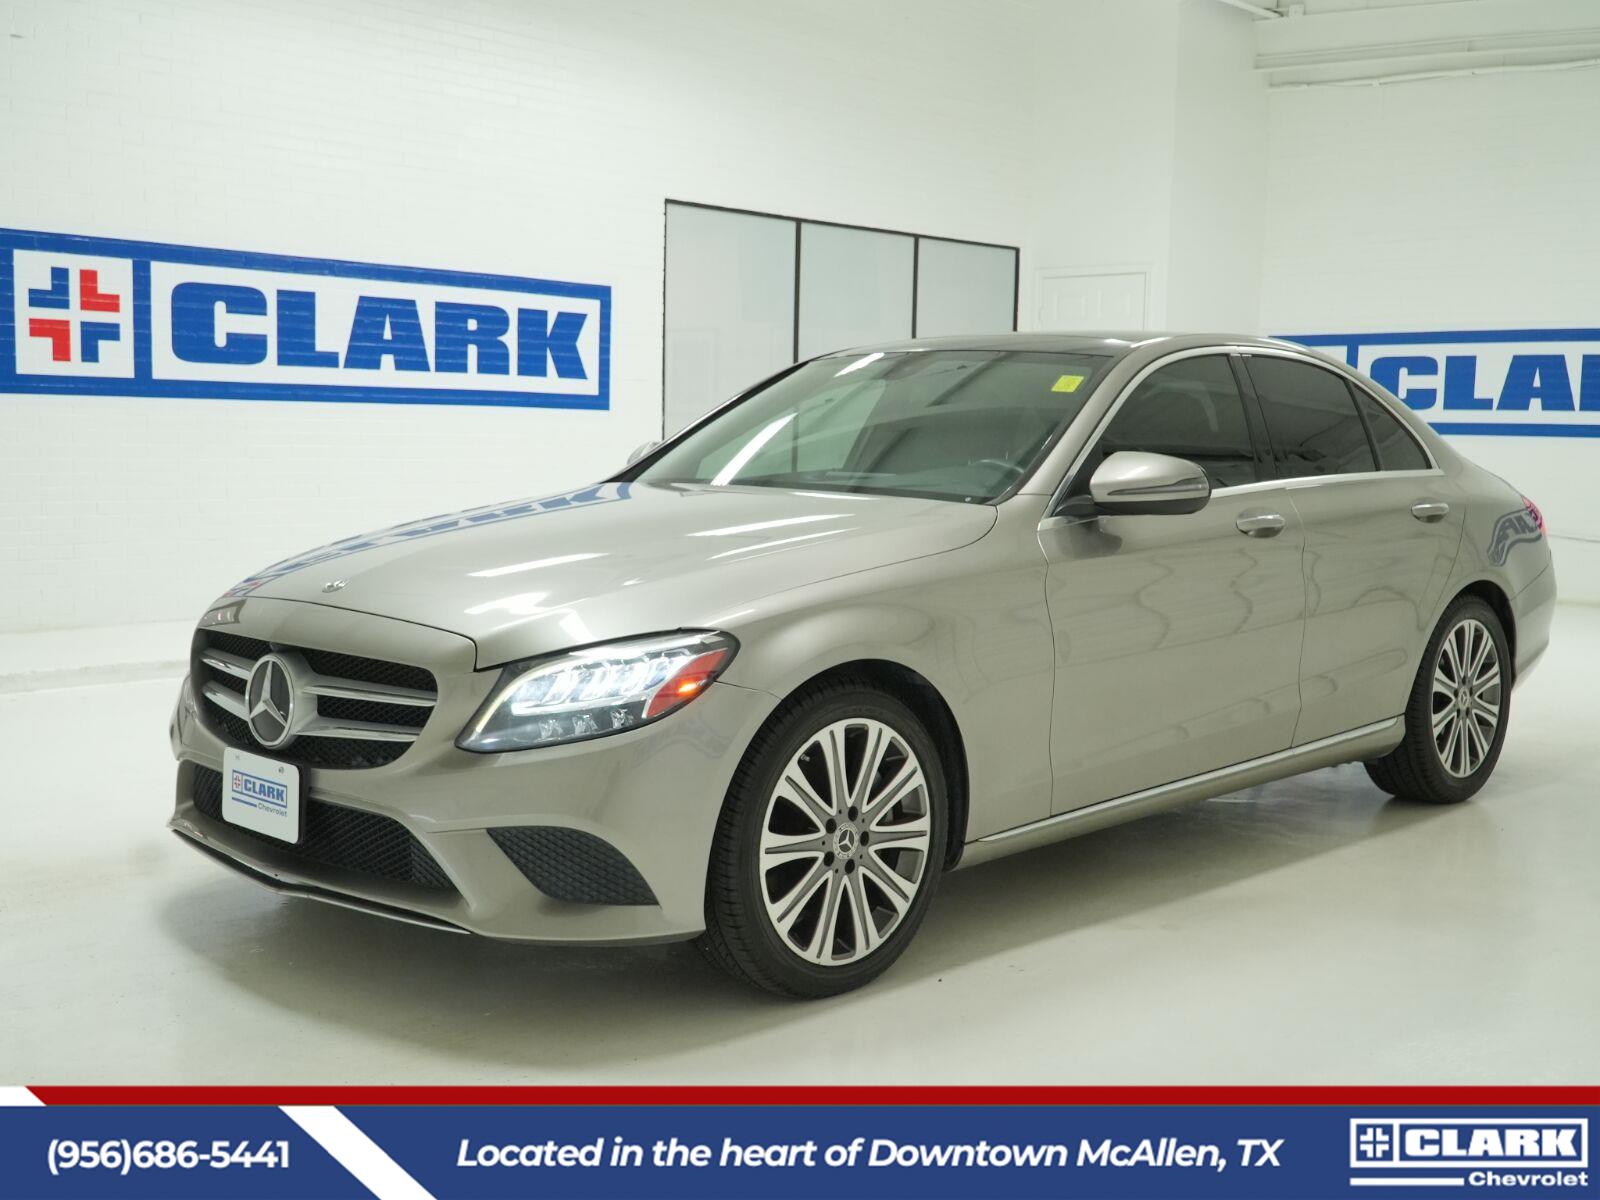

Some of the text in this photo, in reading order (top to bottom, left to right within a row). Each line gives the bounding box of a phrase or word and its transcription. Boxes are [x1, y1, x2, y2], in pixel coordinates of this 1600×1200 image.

[171, 282, 588, 380] CLARK
[1370, 354, 1600, 412] CLA
[244, 779, 284, 802] CLARK
[257, 802, 287, 817] Chevrolet
